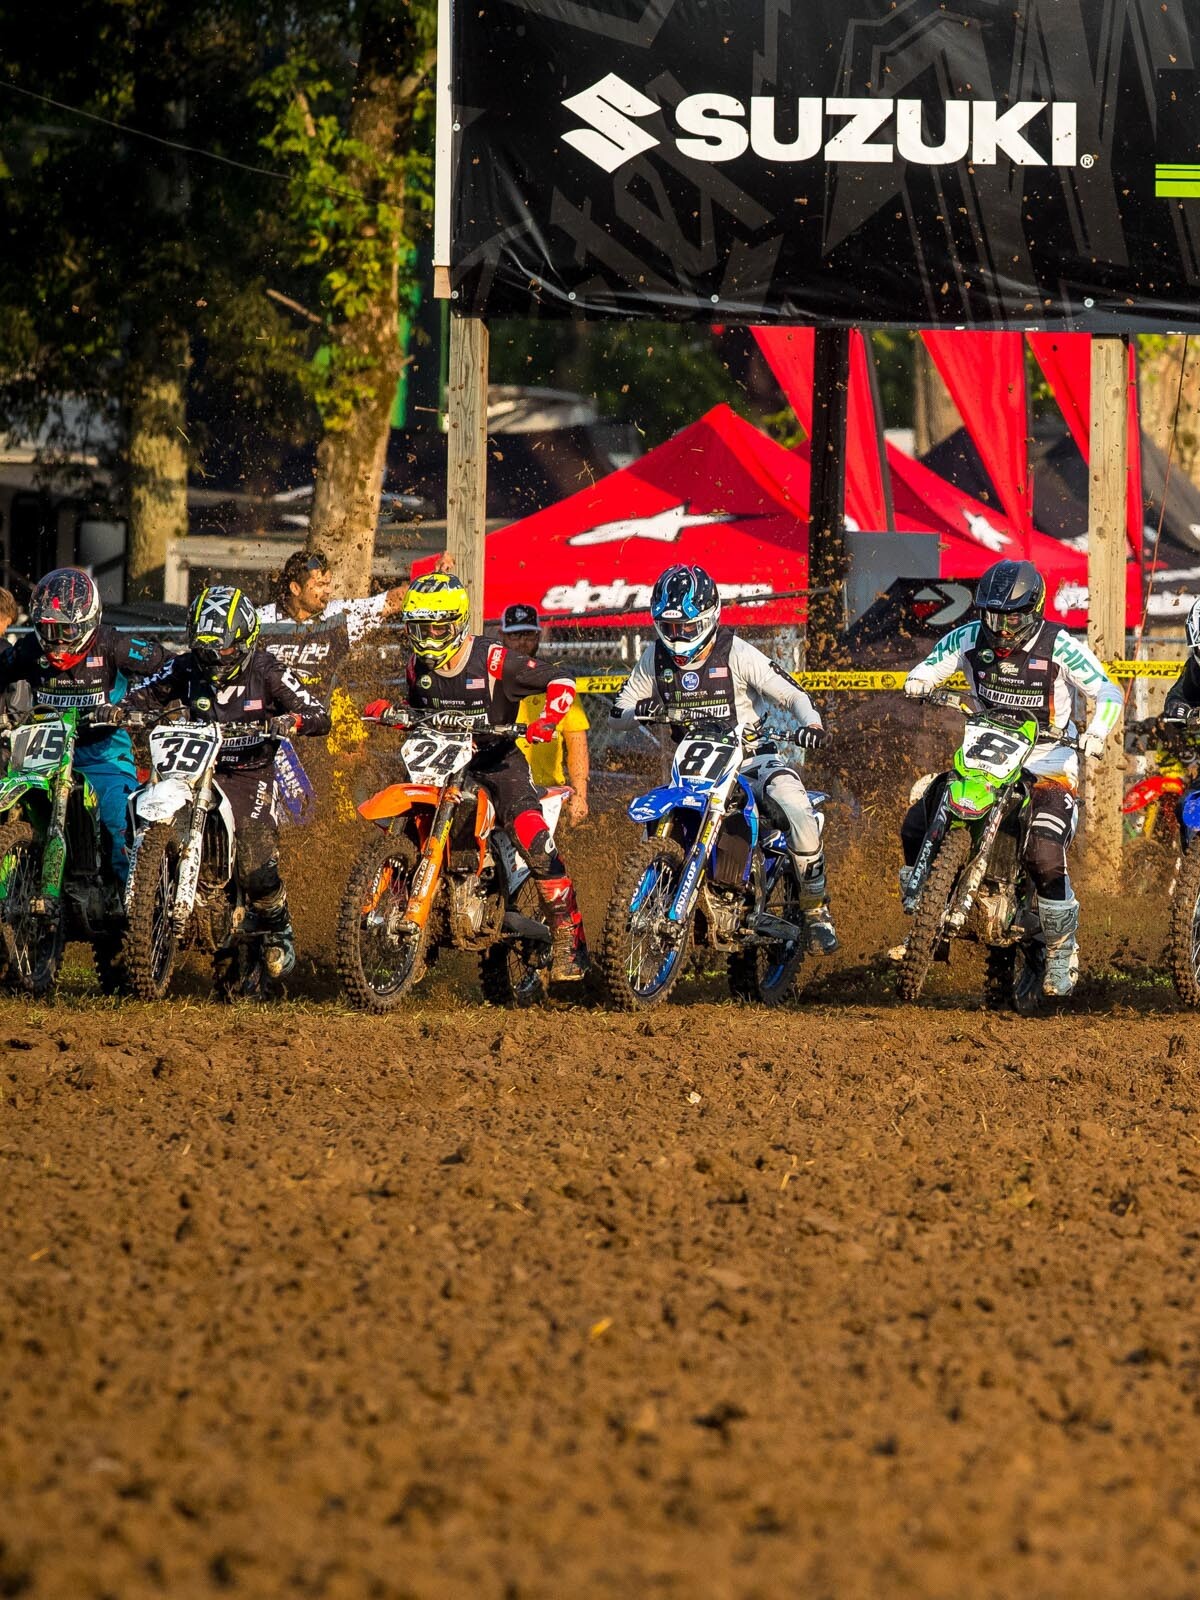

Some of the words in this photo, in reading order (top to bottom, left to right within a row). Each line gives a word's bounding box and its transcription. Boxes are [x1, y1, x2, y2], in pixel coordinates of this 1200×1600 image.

[674, 92, 1079, 167] SUZUKI
[925, 622, 981, 667] SHIFT
[38, 692, 103, 708] CHAMPIONSHIP
[980, 686, 1043, 706] CHAMPIONSHIP
[156, 737, 210, 773] 39
[406, 740, 463, 776] 24
[678, 741, 737, 781] 81
[674, 860, 697, 915] DUNLOP
